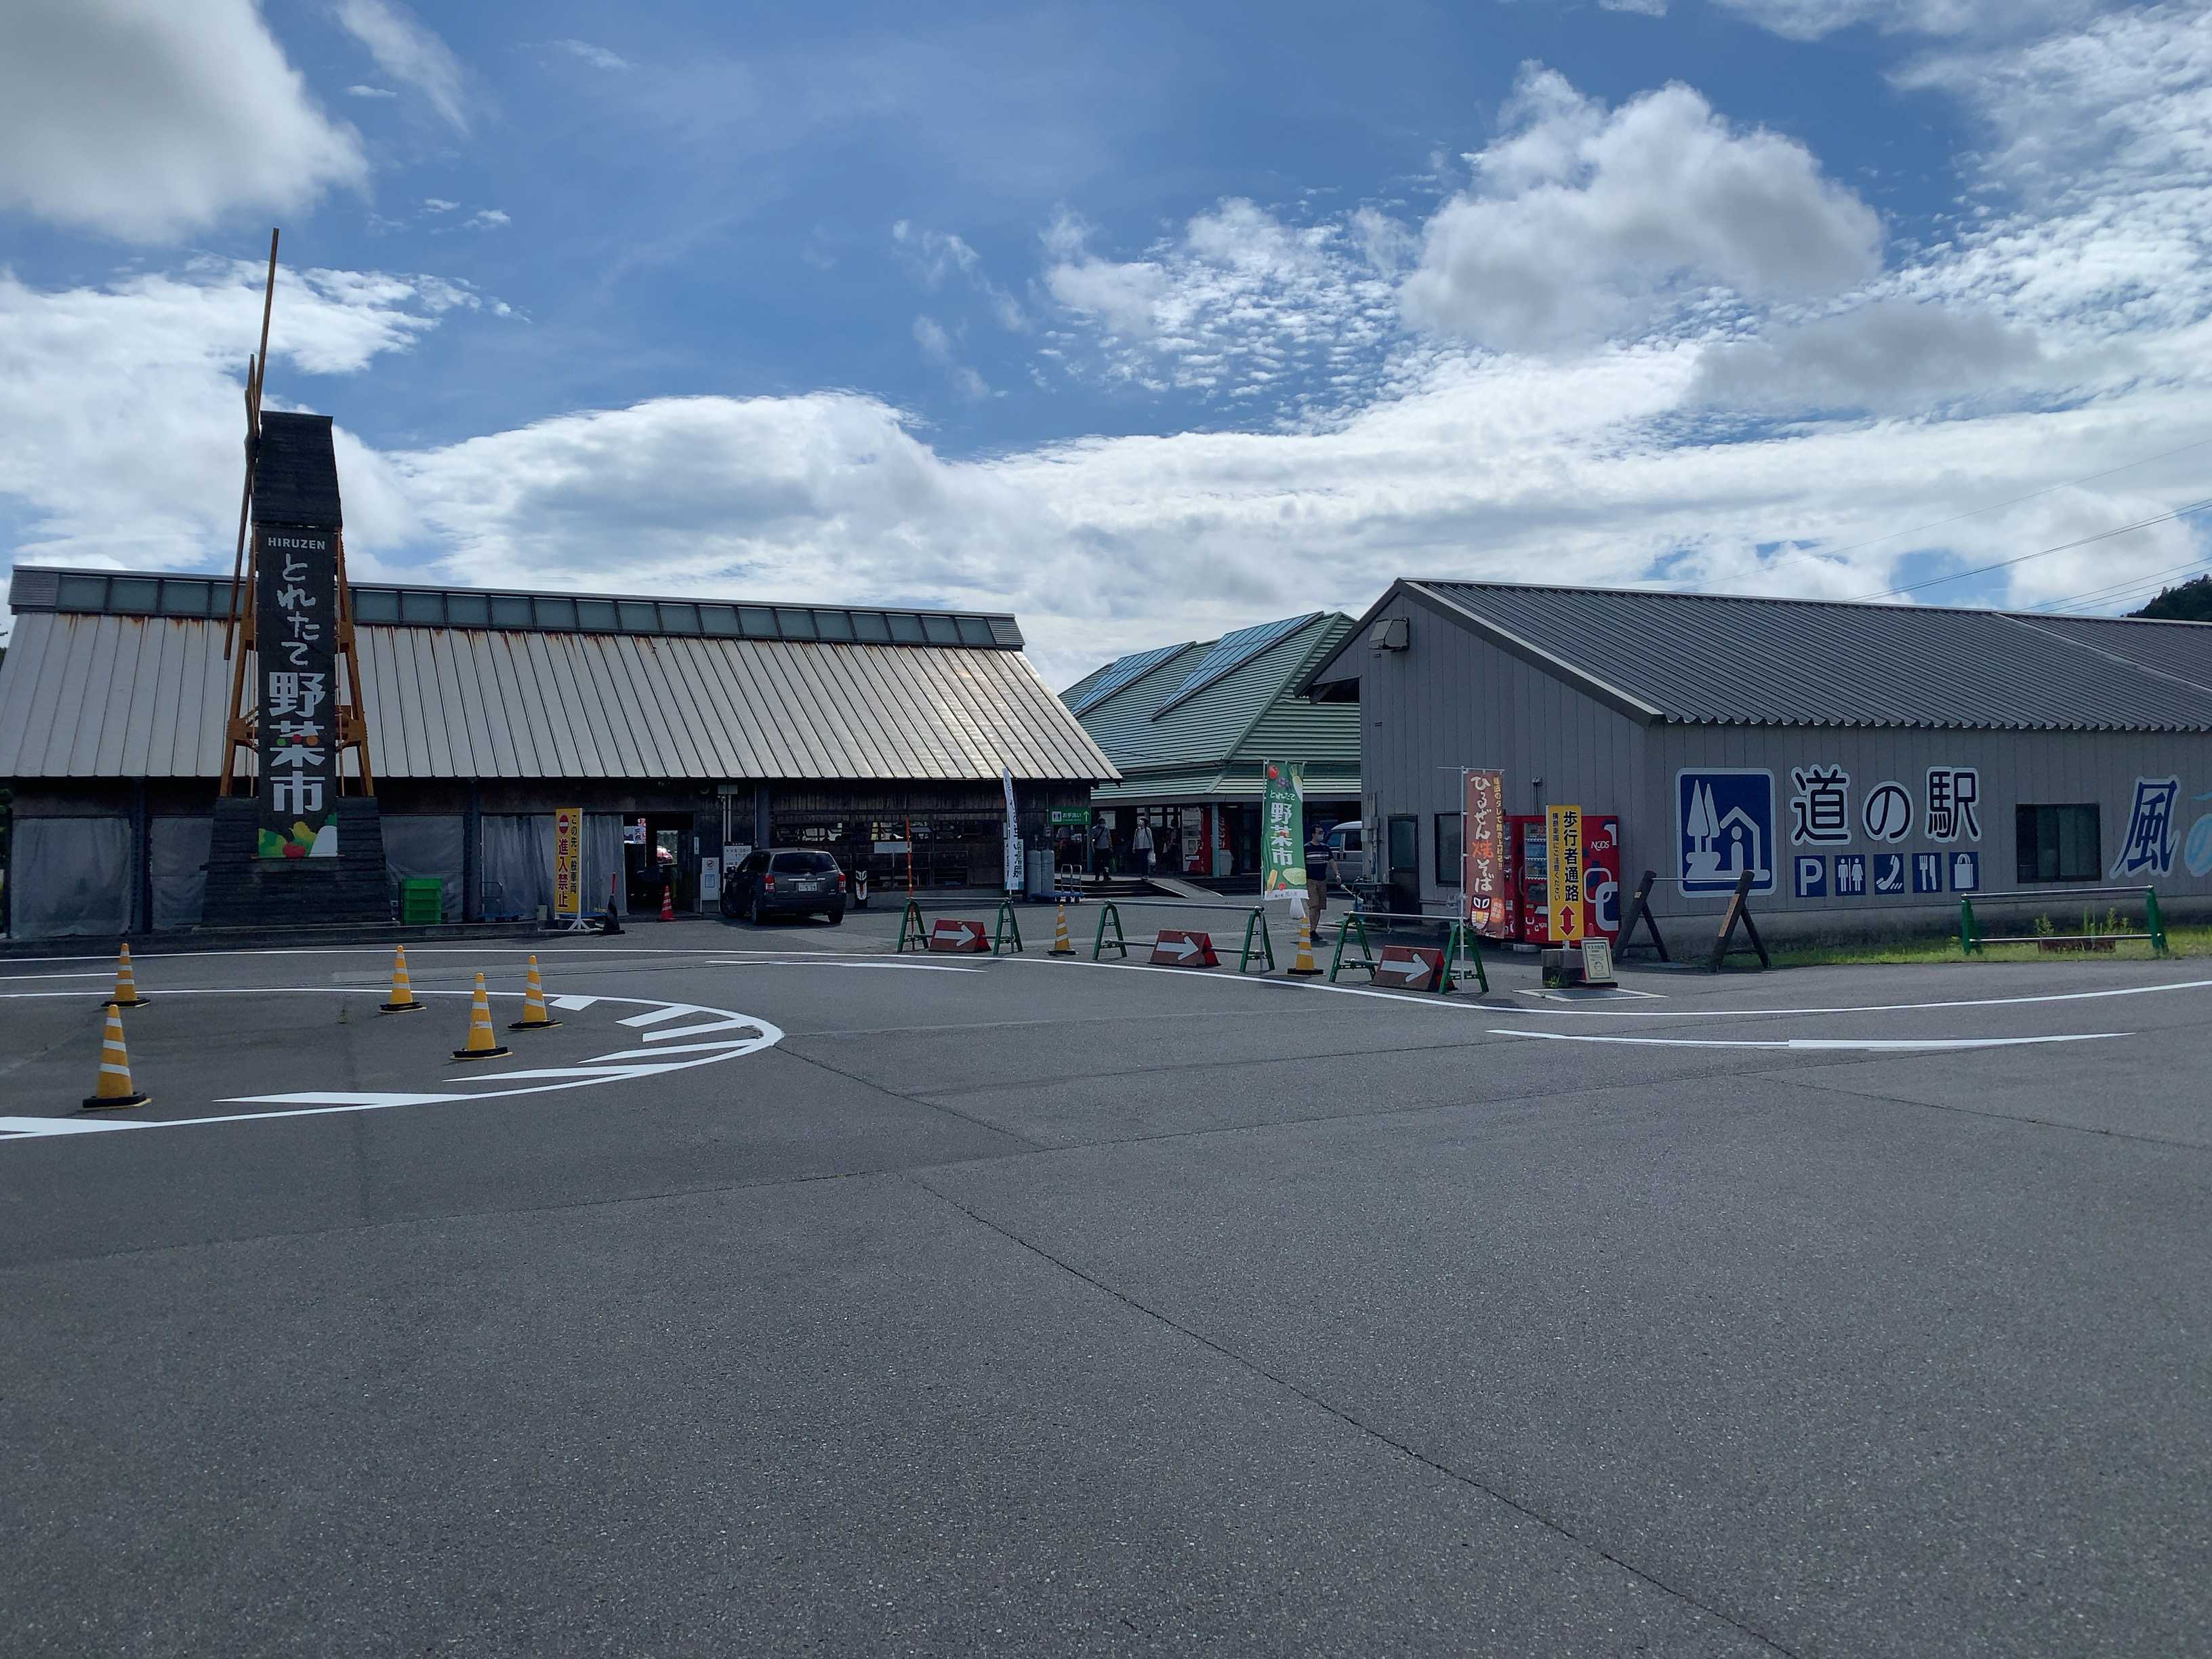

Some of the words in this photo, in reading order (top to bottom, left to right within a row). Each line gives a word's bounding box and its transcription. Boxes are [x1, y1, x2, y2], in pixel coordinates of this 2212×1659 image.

[268, 536, 326, 551] HIRUZEN
[1269, 790, 1296, 801] とれたて
[1791, 764, 1982, 846] 道の駅
[1270, 802, 1294, 866] 野菜市
[1471, 776, 1494, 893] ひるぜん焼そば
[1563, 811, 1579, 902] 歩行者通路
[558, 838, 569, 908] 進入禁止
